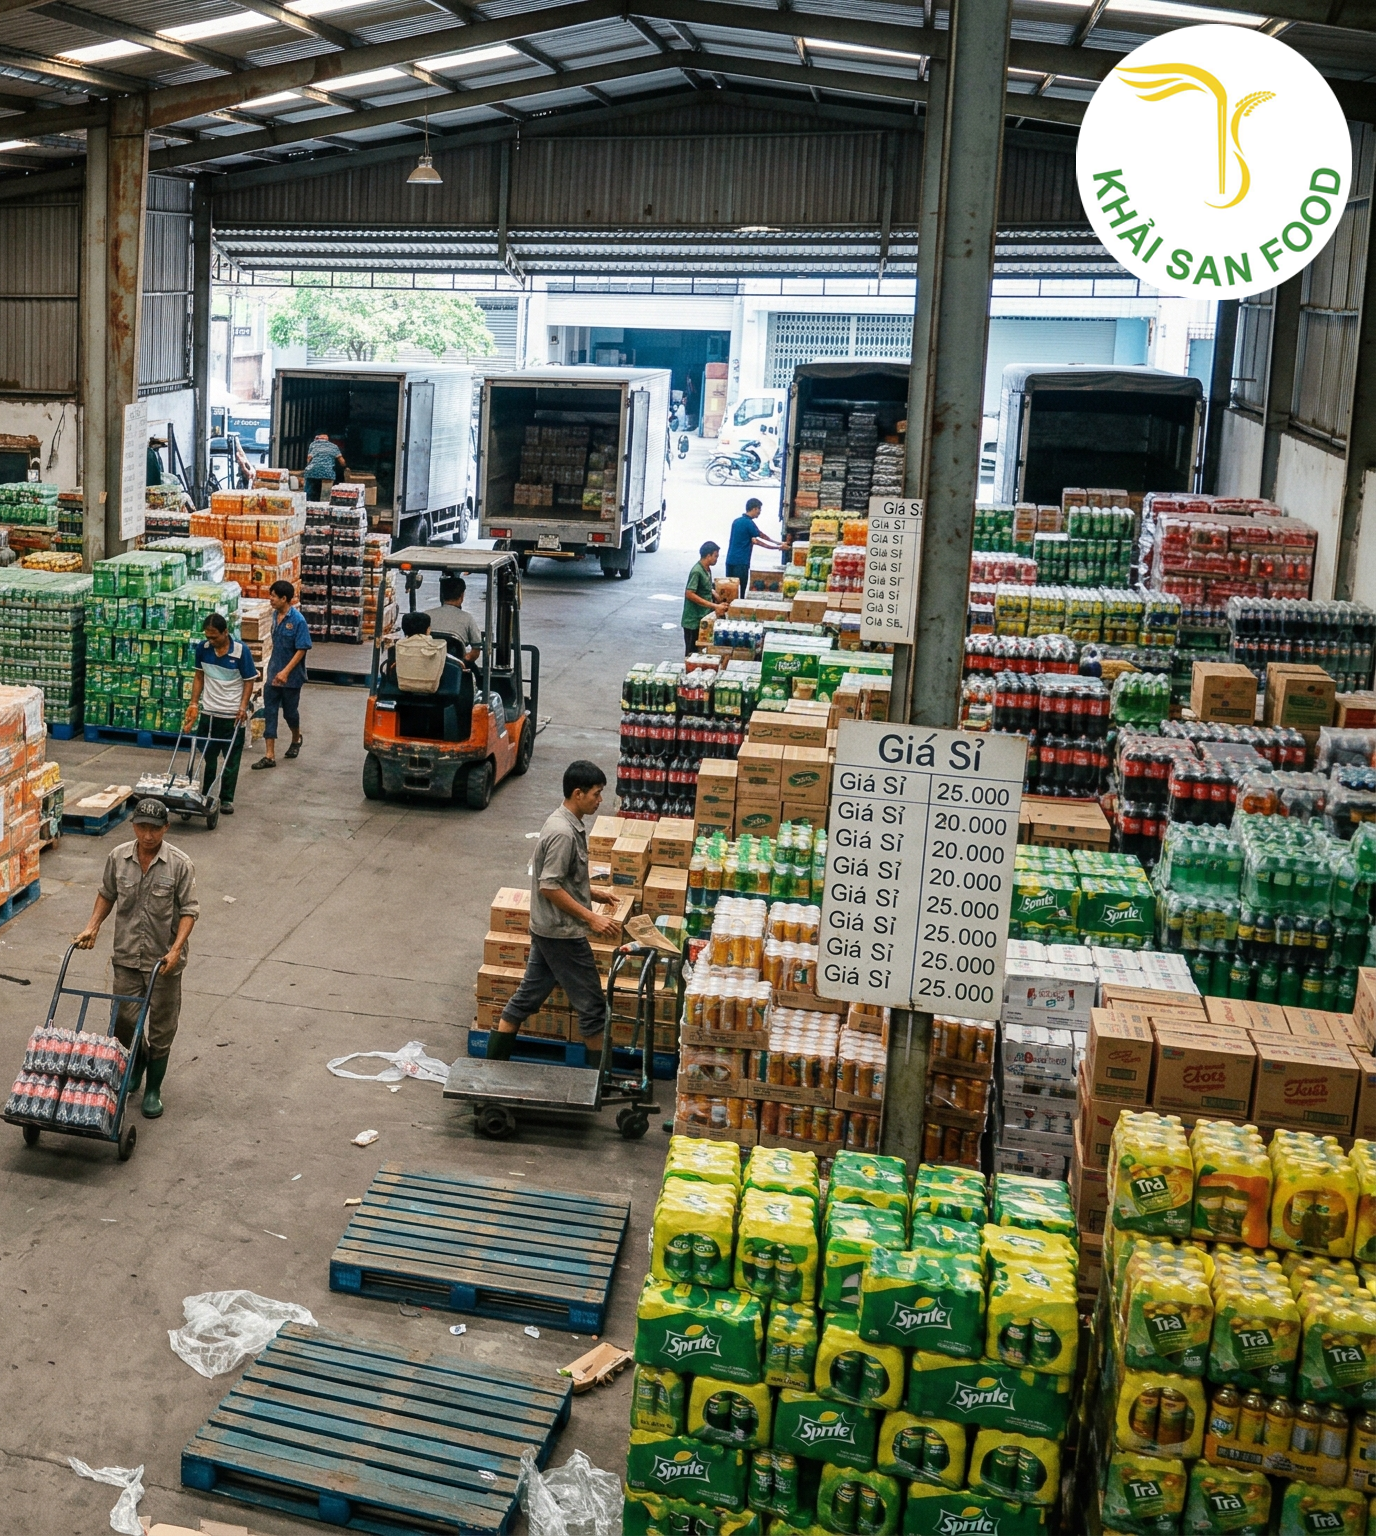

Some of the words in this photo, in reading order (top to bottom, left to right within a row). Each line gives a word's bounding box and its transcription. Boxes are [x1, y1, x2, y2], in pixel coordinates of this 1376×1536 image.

[878, 733, 938, 768] Giá
[948, 738, 985, 771] Sỉ
[840, 772, 875, 792] Giá
[883, 776, 908, 795] Sỉ
[937, 783, 1010, 806] 25.000
[838, 801, 873, 822] Giá
[882, 806, 906, 825] Sỉ
[934, 812, 1007, 836] 20.000
[835, 829, 871, 849] Giá
[880, 833, 904, 852] Sỉ
[932, 840, 1005, 864] 20.000
[833, 856, 868, 877] Giá
[878, 861, 902, 880] Sỉ
[929, 868, 1001, 892] 20.000
[831, 883, 866, 904] Giá
[876, 888, 899, 908] Sỉ
[927, 896, 999, 920] 25.000
[829, 910, 864, 931] Giá
[873, 916, 897, 935] Sỉ
[924, 924, 997, 948] 25.000
[827, 937, 861, 958] Giá
[871, 943, 894, 962] Sỉ
[824, 964, 859, 985] Giá
[868, 970, 891, 989] Sỉ
[918, 978, 993, 1003] 25.000
[667, 1334, 716, 1356] Sprite
[956, 1386, 1009, 1408] Sprite
[657, 1460, 704, 1480] Sprite
